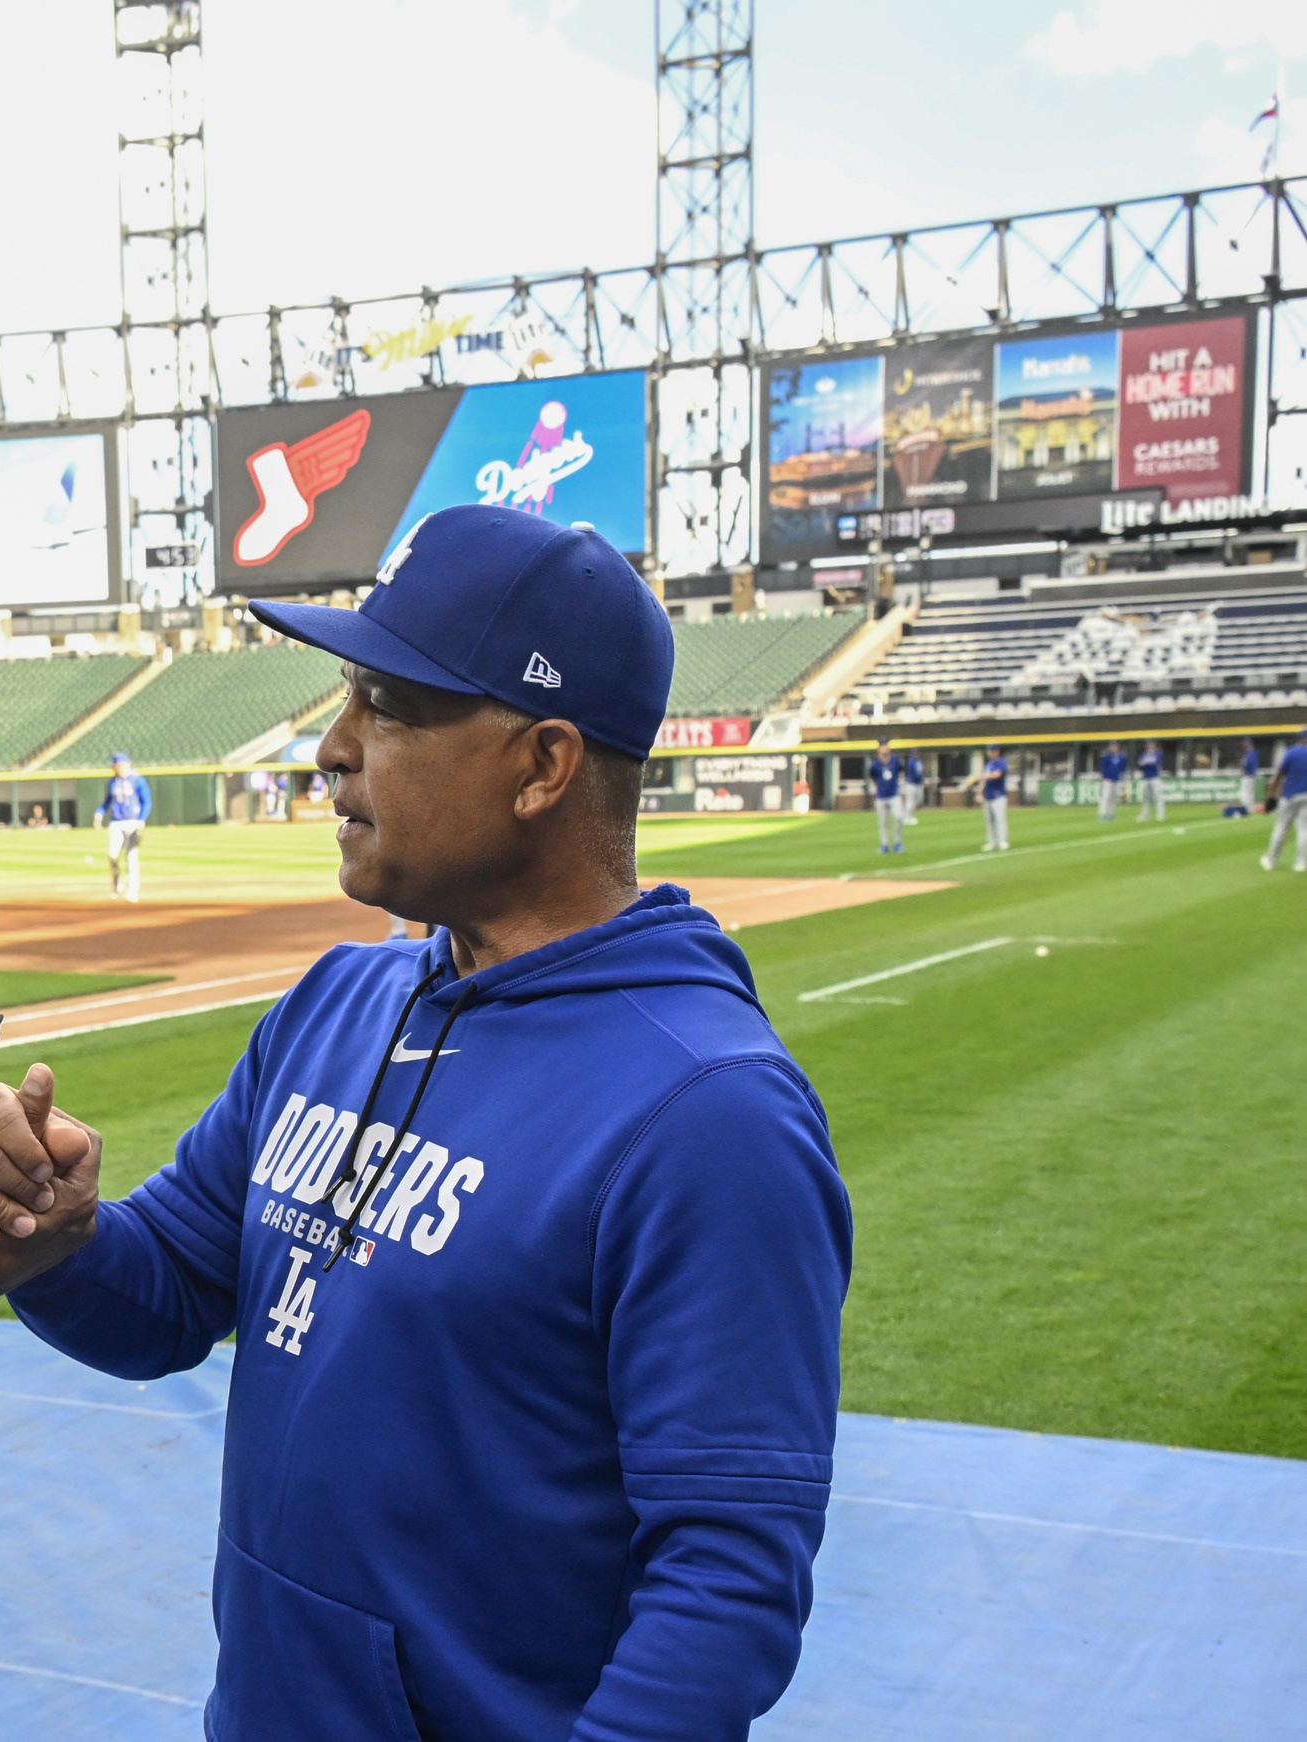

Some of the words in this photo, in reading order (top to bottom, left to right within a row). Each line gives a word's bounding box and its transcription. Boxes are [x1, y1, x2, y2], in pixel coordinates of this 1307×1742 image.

[1148, 348, 1189, 373] HIT
[1193, 345, 1213, 369] A
[1125, 372, 1186, 405] HOME
[1189, 363, 1236, 397] RUN
[1148, 397, 1211, 422] WITH
[475, 430, 594, 506] Dodgers
[1132, 436, 1220, 463] CAESARS
[1100, 500, 1156, 535] Lite
[251, 1092, 485, 1256] DODGERS
[265, 1246, 316, 1356] LA
